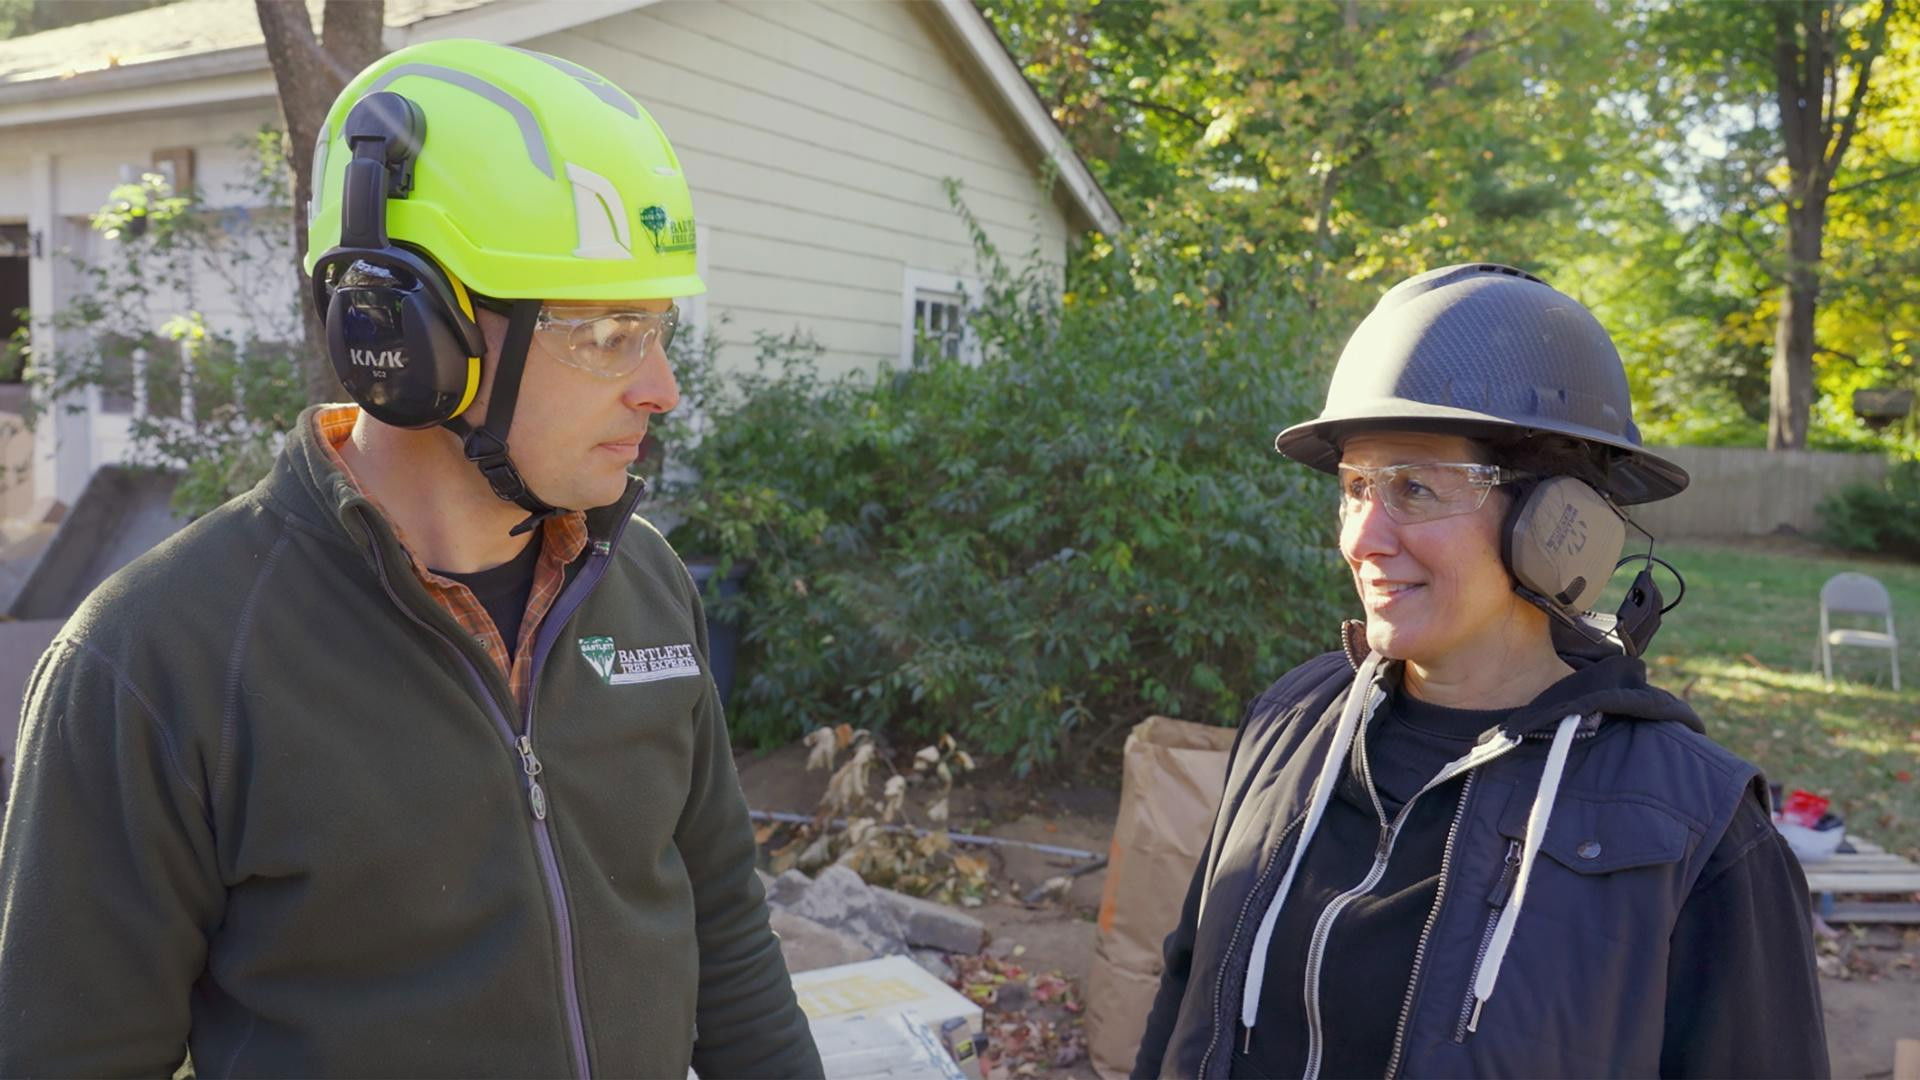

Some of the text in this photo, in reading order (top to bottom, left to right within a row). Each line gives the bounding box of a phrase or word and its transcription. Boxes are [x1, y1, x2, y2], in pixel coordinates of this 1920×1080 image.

[350, 348, 404, 368] KASK
[618, 644, 693, 663] BARTLETT
[621, 657, 696, 674] TREE EXPERTS
